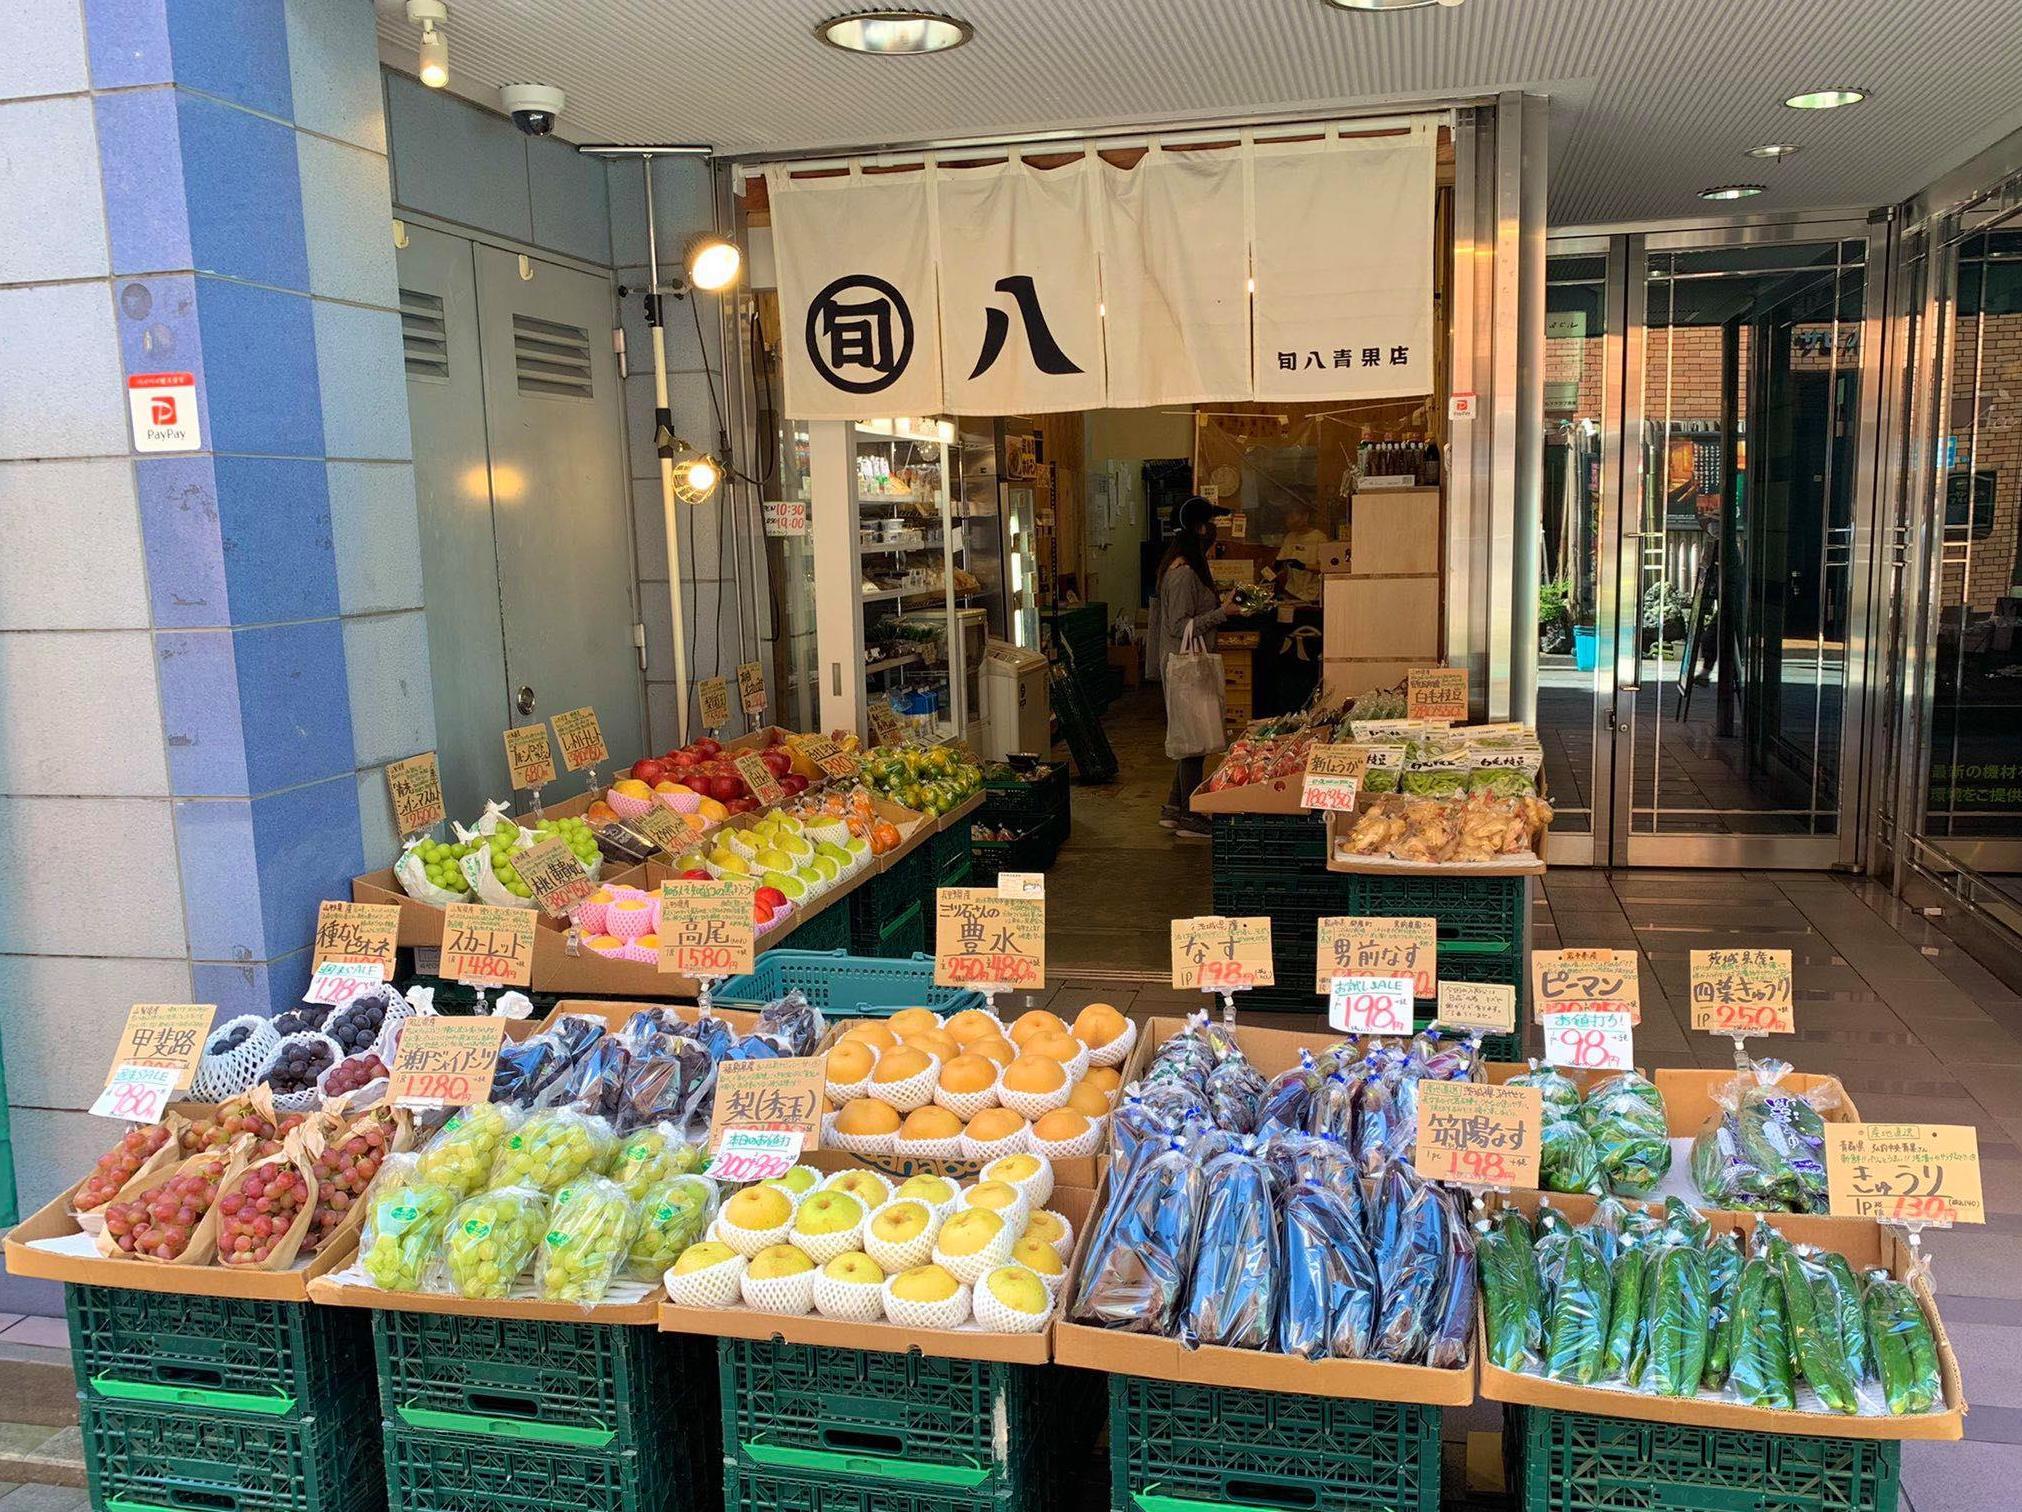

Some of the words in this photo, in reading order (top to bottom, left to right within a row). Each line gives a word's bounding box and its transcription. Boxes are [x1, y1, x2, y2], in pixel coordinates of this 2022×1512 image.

[969, 275, 1084, 381] 八
[1278, 346, 1409, 370] 旬八青果店
[147, 429, 186, 441] PayPay
[1311, 754, 1364, 774] 新しょうが
[448, 929, 526, 957] スカーレット
[678, 918, 729, 945] 高尾
[957, 917, 1023, 955] 豊水
[1180, 936, 1240, 964] なす
[1334, 938, 1421, 968] 男前なす
[1542, 970, 1624, 998] ピーマン
[1694, 976, 1791, 1003] 四葉きゅうり
[396, 1046, 498, 1072] 瀬戸ジャイアンツ
[725, 1088, 816, 1123] 梨(秀玉)
[1428, 1113, 1527, 1151] 筑陽なす
[1853, 1165, 1944, 1197] きゅうり
